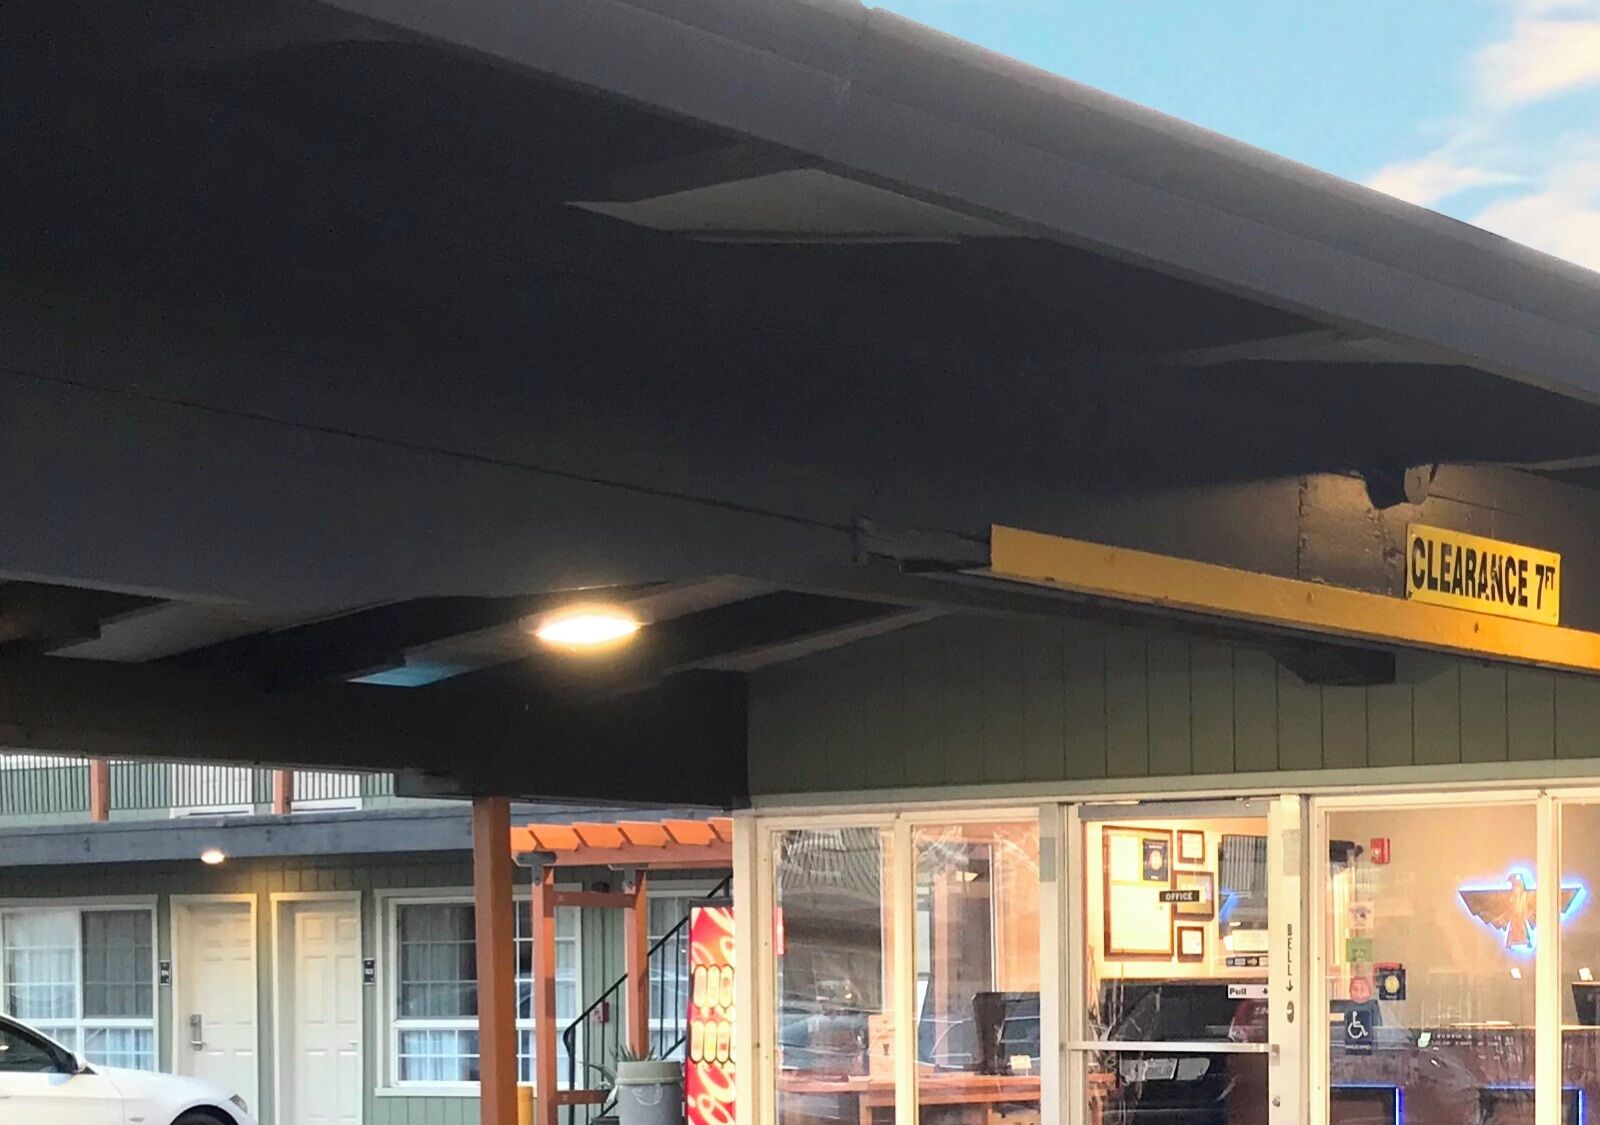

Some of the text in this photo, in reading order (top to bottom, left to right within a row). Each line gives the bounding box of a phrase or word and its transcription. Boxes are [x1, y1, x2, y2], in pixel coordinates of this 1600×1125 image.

[1411, 536, 1528, 607] CLEARANCE
[1165, 892, 1193, 901] OFFICE
[1229, 987, 1247, 995] Pull
